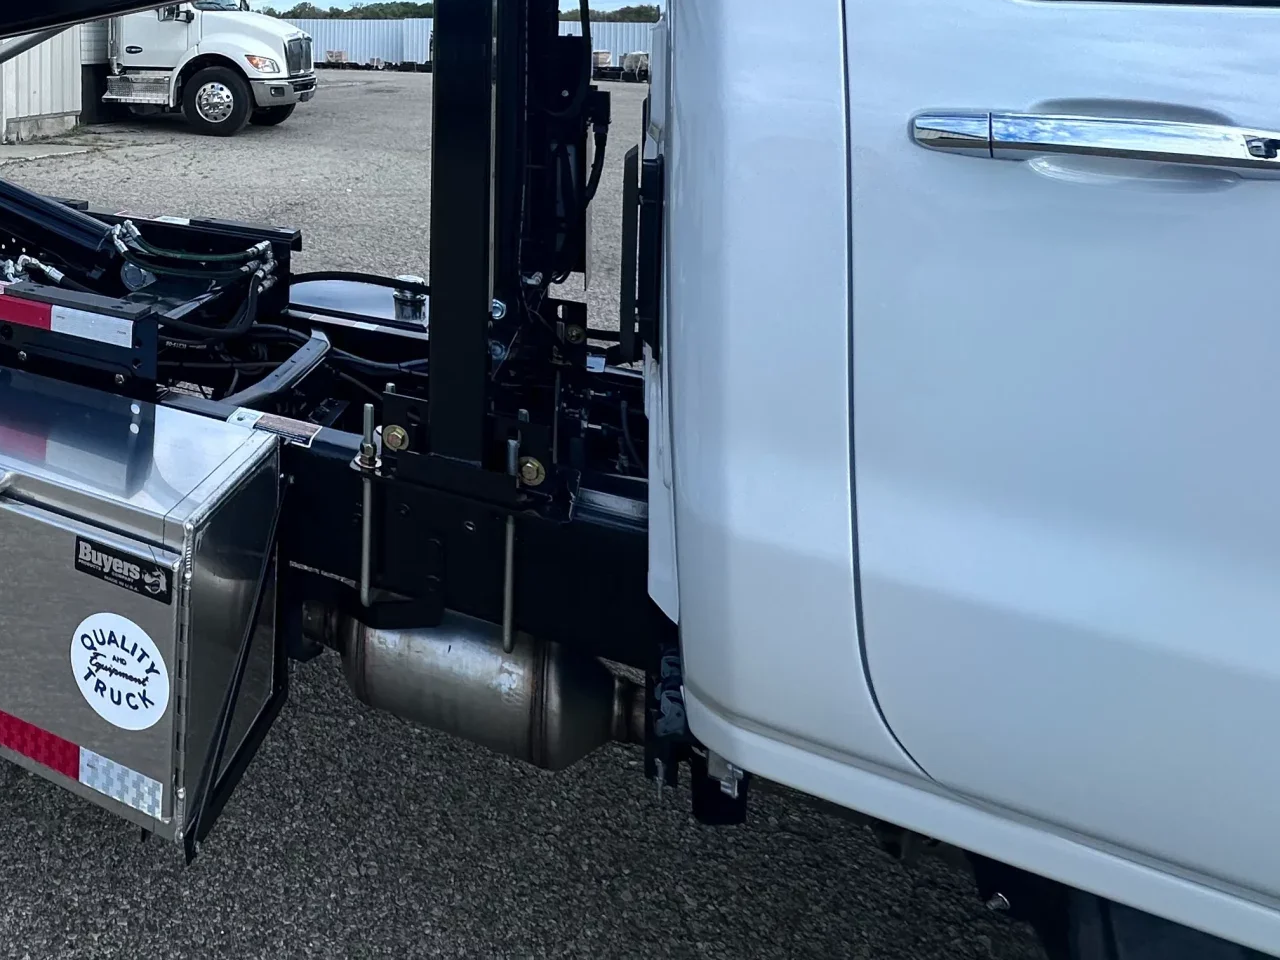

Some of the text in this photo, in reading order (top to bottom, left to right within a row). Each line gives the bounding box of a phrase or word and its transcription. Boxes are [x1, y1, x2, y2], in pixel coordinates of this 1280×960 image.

[78, 541, 141, 579] Buyers
[80, 628, 160, 675] QUALITY
[89, 651, 149, 687] Equipment
[112, 654, 127, 666] AND
[83, 666, 155, 710] TRUCK
